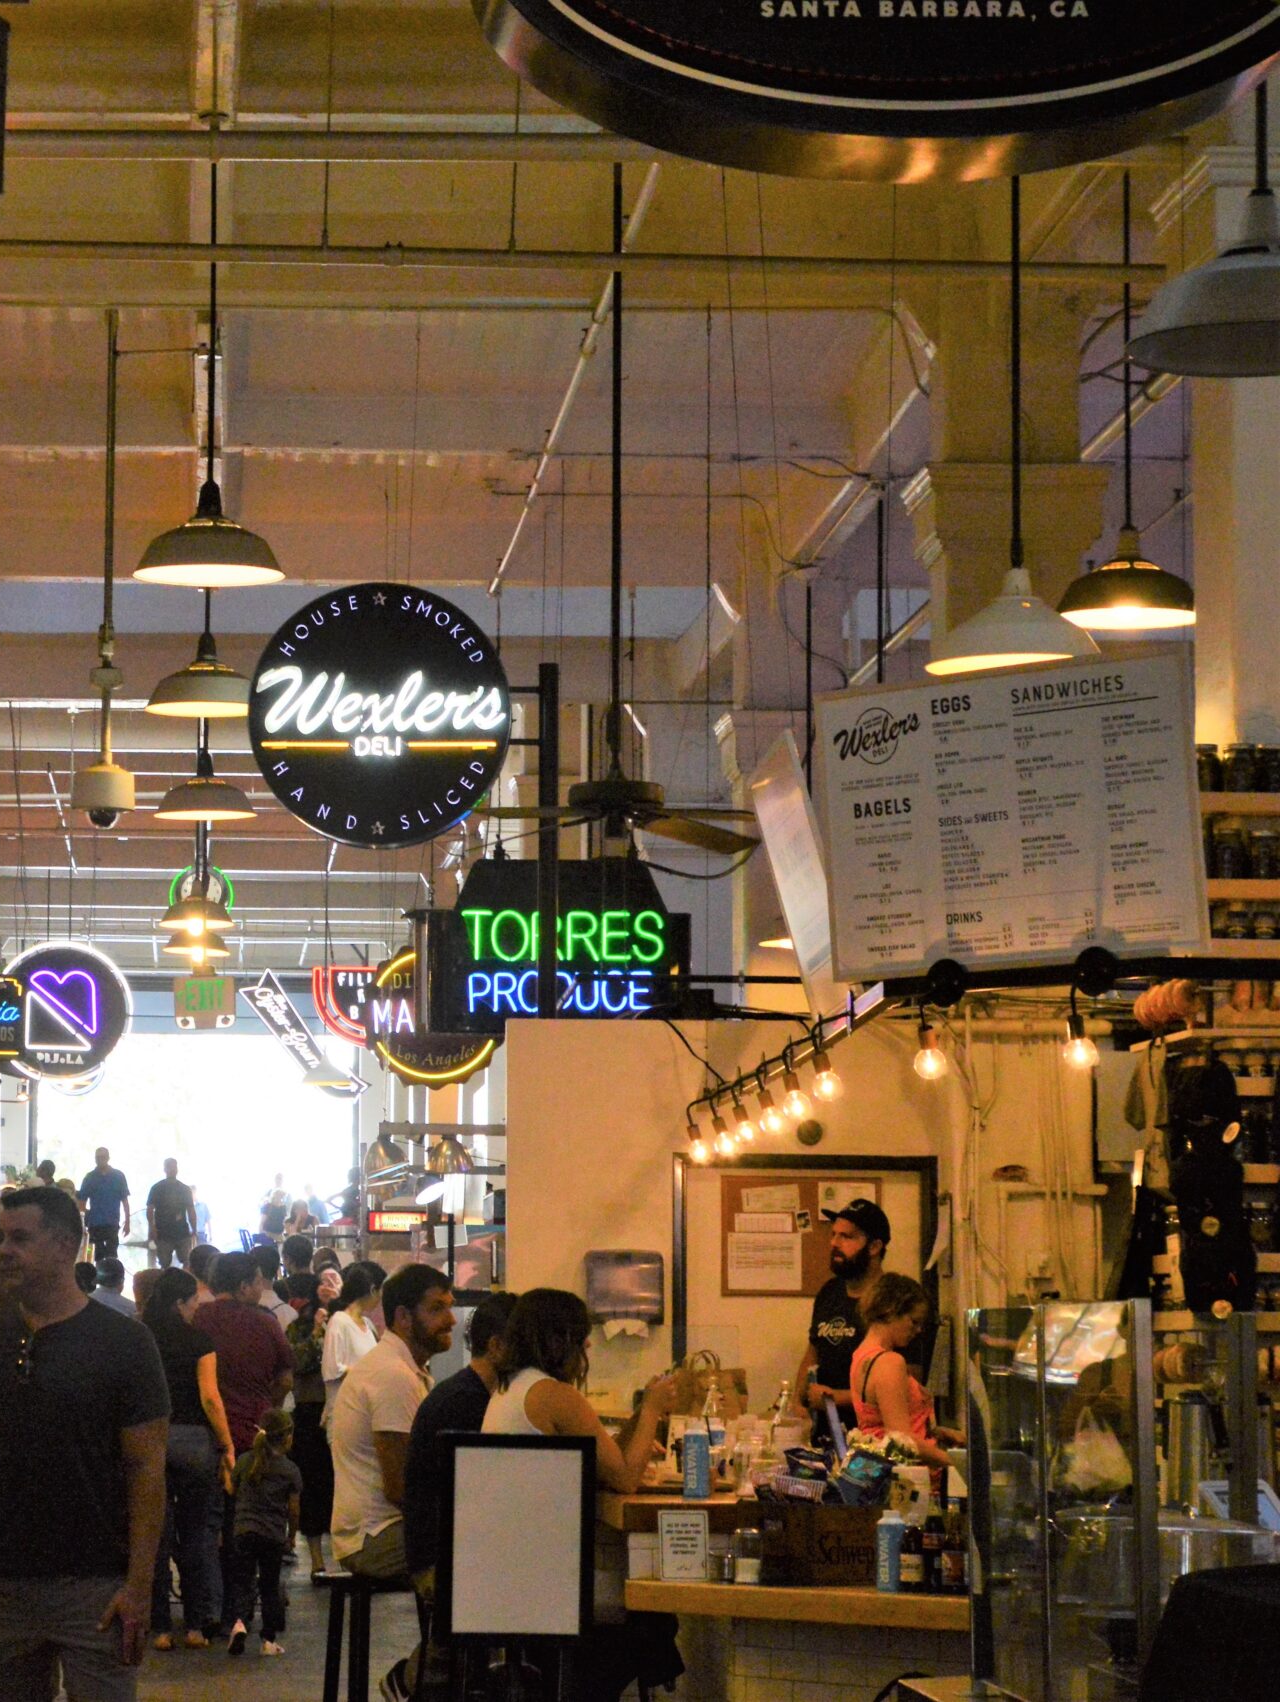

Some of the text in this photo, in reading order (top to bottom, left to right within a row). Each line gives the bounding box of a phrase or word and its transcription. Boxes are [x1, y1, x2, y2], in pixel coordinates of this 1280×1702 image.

[760, 0, 1090, 23] SANTA BARBARA, CA
[279, 595, 484, 664] HOUSE SMOKED
[256, 665, 506, 735] Wexler's
[1011, 674, 1124, 704] SANDWICHES
[931, 694, 971, 715] EGGS
[354, 736, 402, 757] DELI
[833, 713, 920, 761] Wexler's
[273, 761, 484, 830] HAND SLICED
[854, 797, 912, 819] BAGELS
[938, 815, 963, 827] SIDES
[974, 810, 1009, 824] SWEETS
[946, 911, 983, 925] DRINKS
[185, 979, 225, 1012] EXIT
[422, 1044, 476, 1070] Angeles
